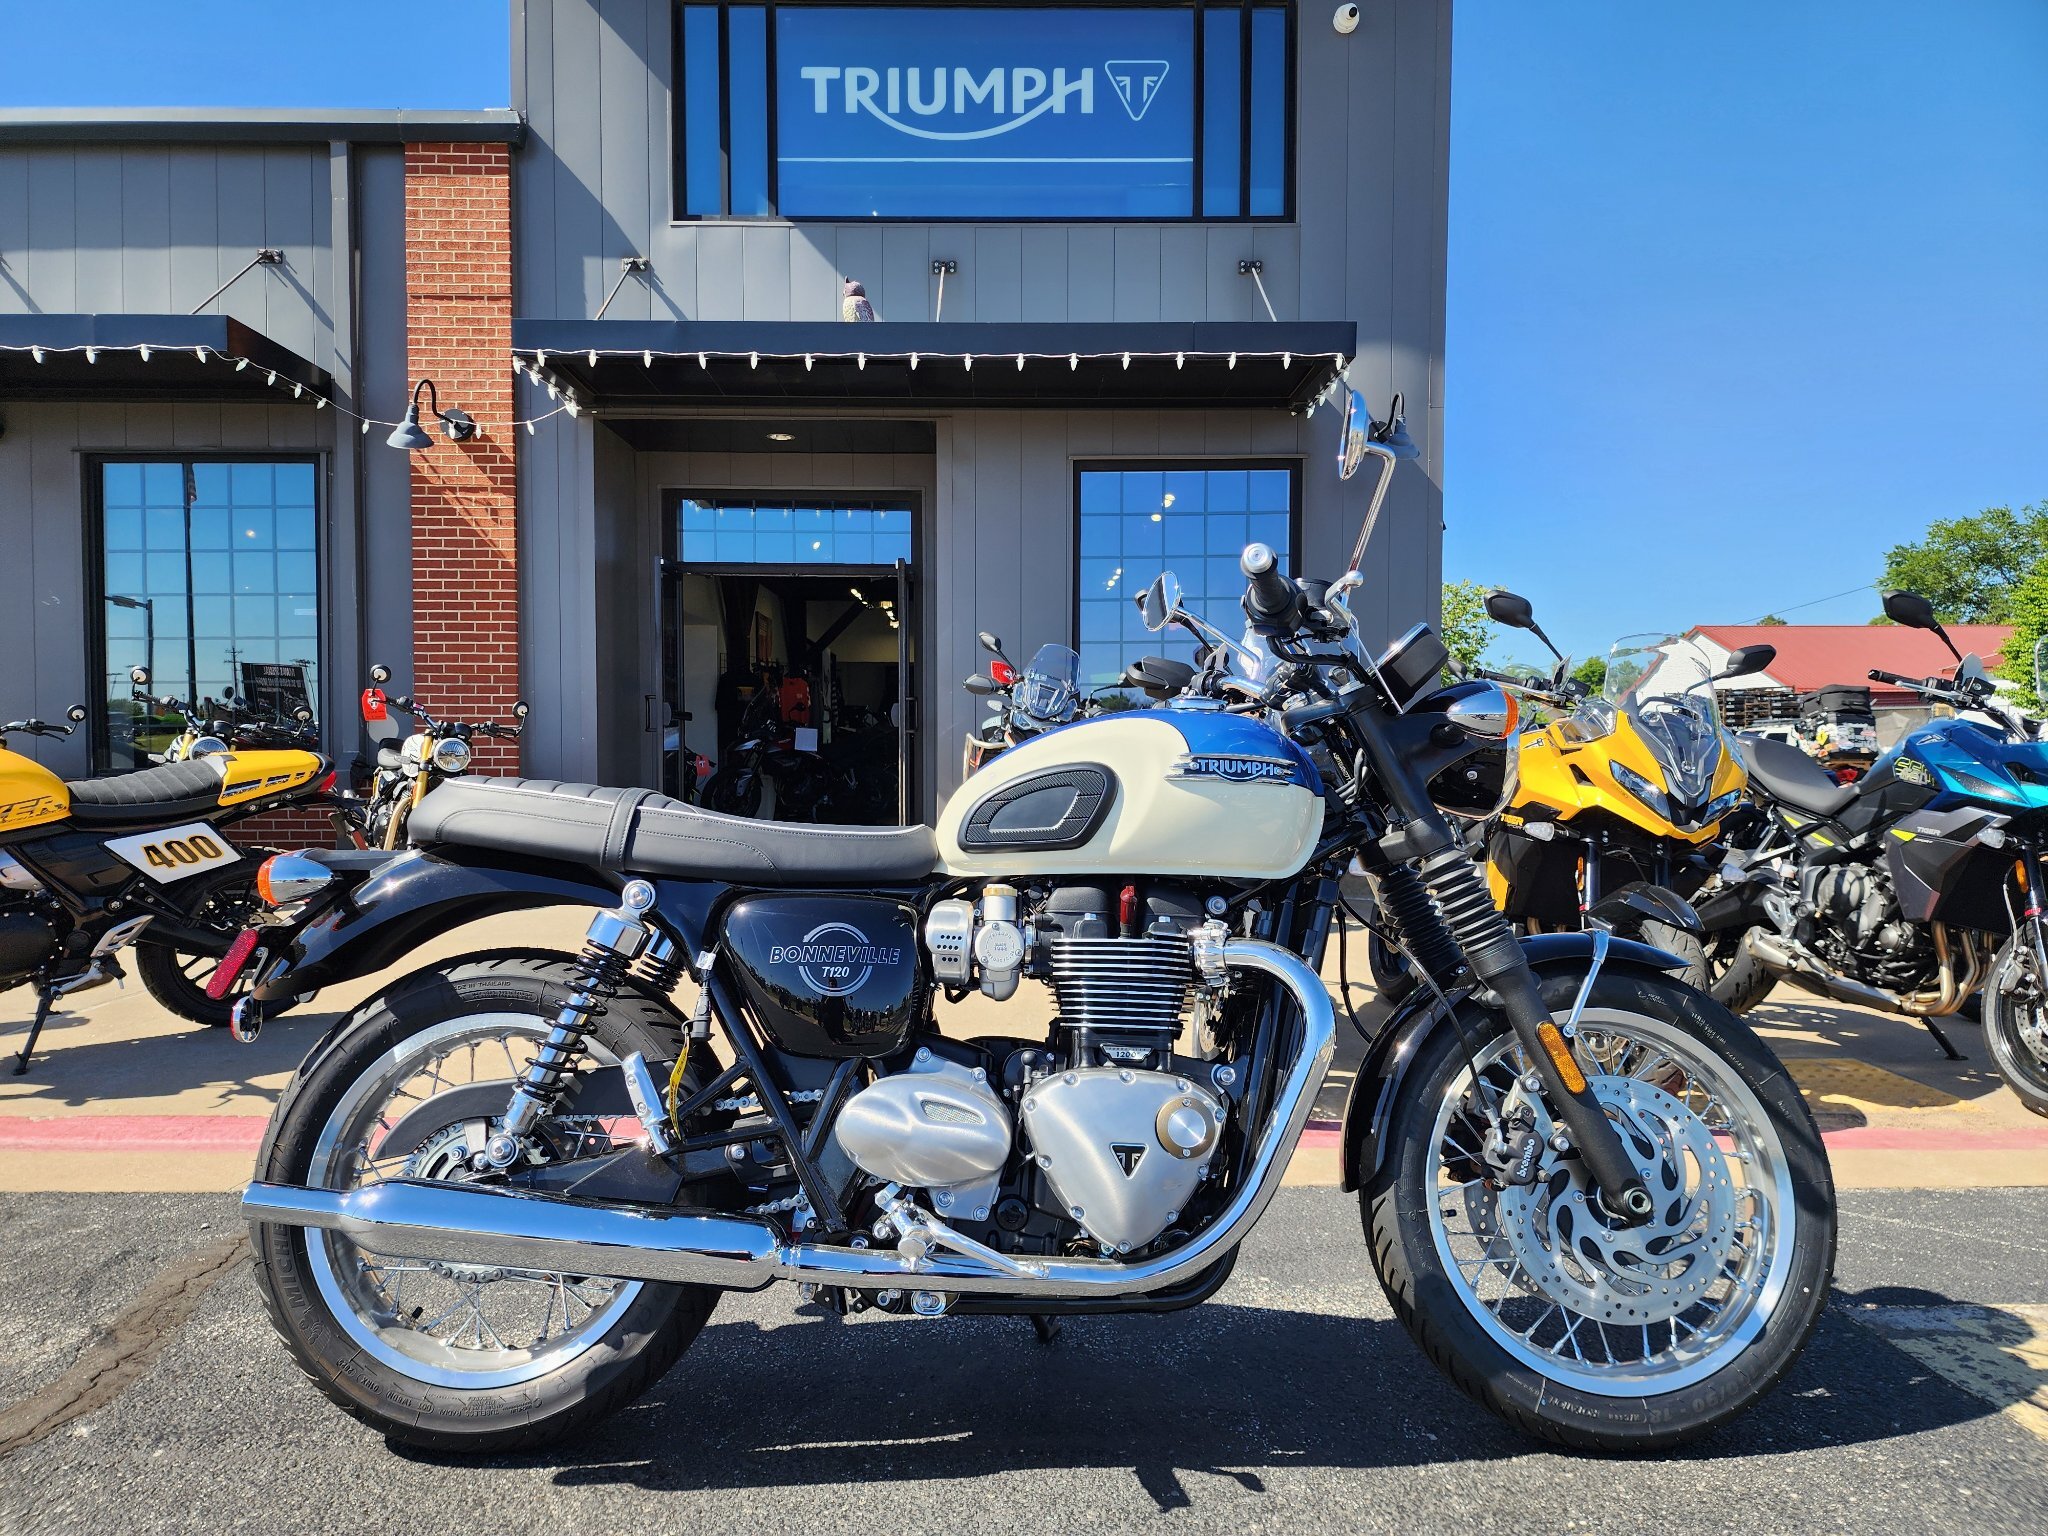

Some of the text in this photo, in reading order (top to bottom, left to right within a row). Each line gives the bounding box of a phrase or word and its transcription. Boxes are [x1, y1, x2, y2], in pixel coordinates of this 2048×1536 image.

[801, 66, 1094, 140] TRIUMPH
[1198, 758, 1275, 780] TRIUMPH
[1917, 826, 1941, 836] TIGER
[142, 834, 223, 869] 400
[769, 945, 901, 965] BONNEVILLE
[821, 966, 850, 978] T120
[1516, 1138, 1535, 1178] brembo
[271, 1223, 306, 1308] MICHE
